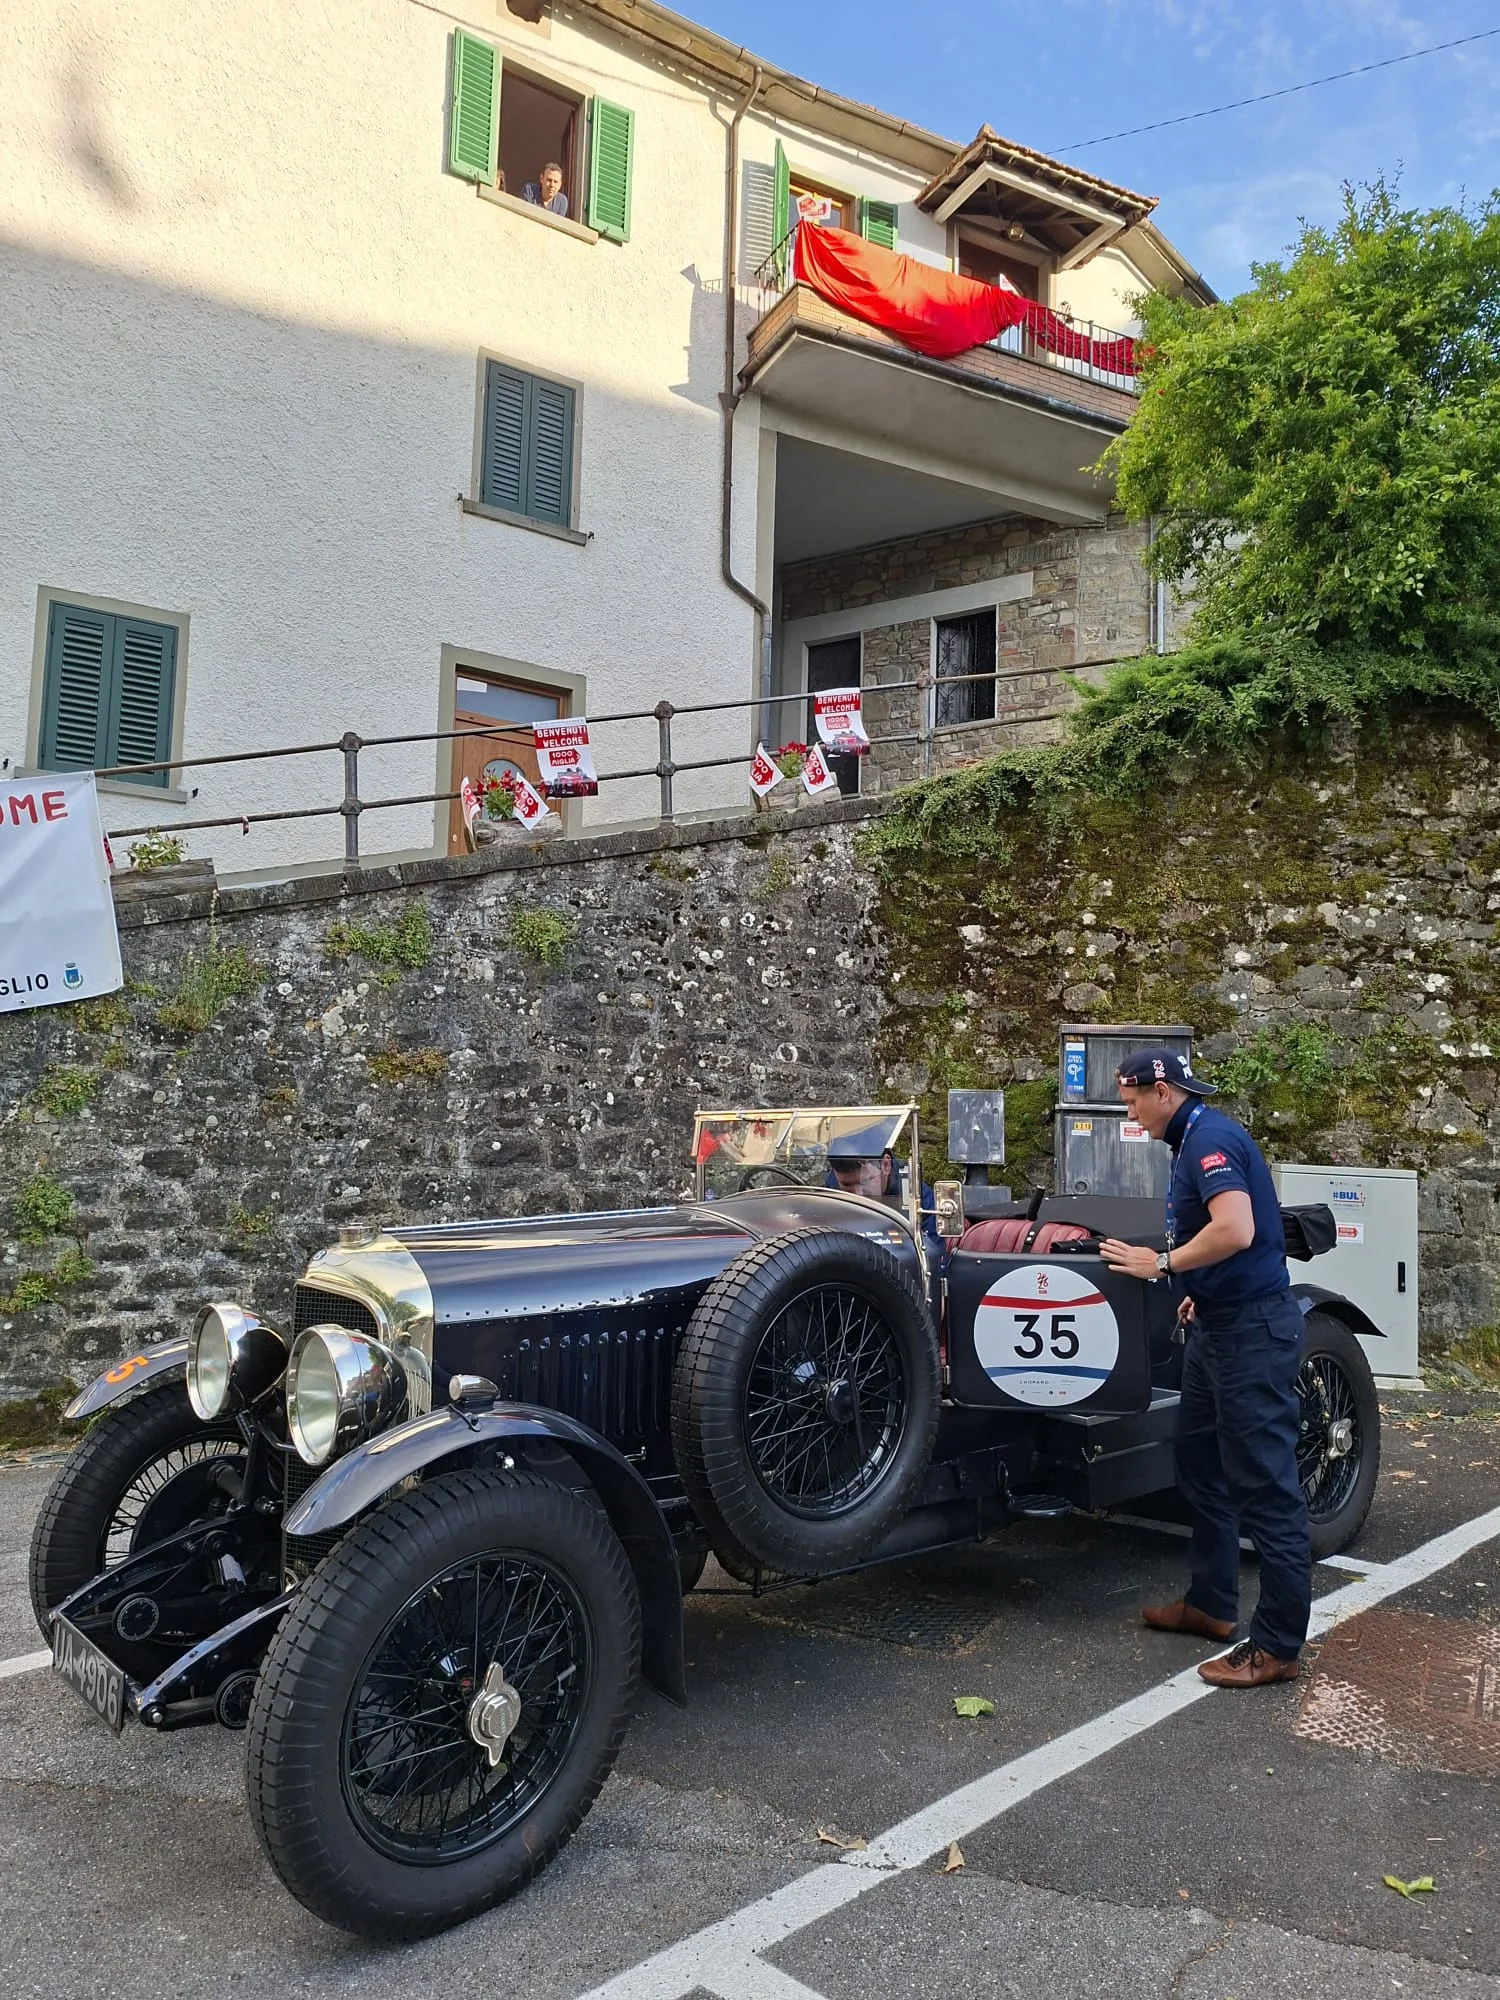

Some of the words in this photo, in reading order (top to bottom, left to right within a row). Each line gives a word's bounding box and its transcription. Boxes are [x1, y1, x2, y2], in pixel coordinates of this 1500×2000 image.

[817, 694, 860, 704] BENVENUTI
[821, 703, 856, 714] WELCOME
[536, 726, 587, 737] BENVENUTI
[827, 722, 848, 730] MIGLIA
[542, 736, 584, 748] WELCOME
[551, 750, 573, 759] 1000
[551, 757, 576, 766] MIGLIA
[0, 790, 68, 826] ME
[1204, 1167, 1232, 1178] CHOPARD
[1013, 1314, 1080, 1360] 35
